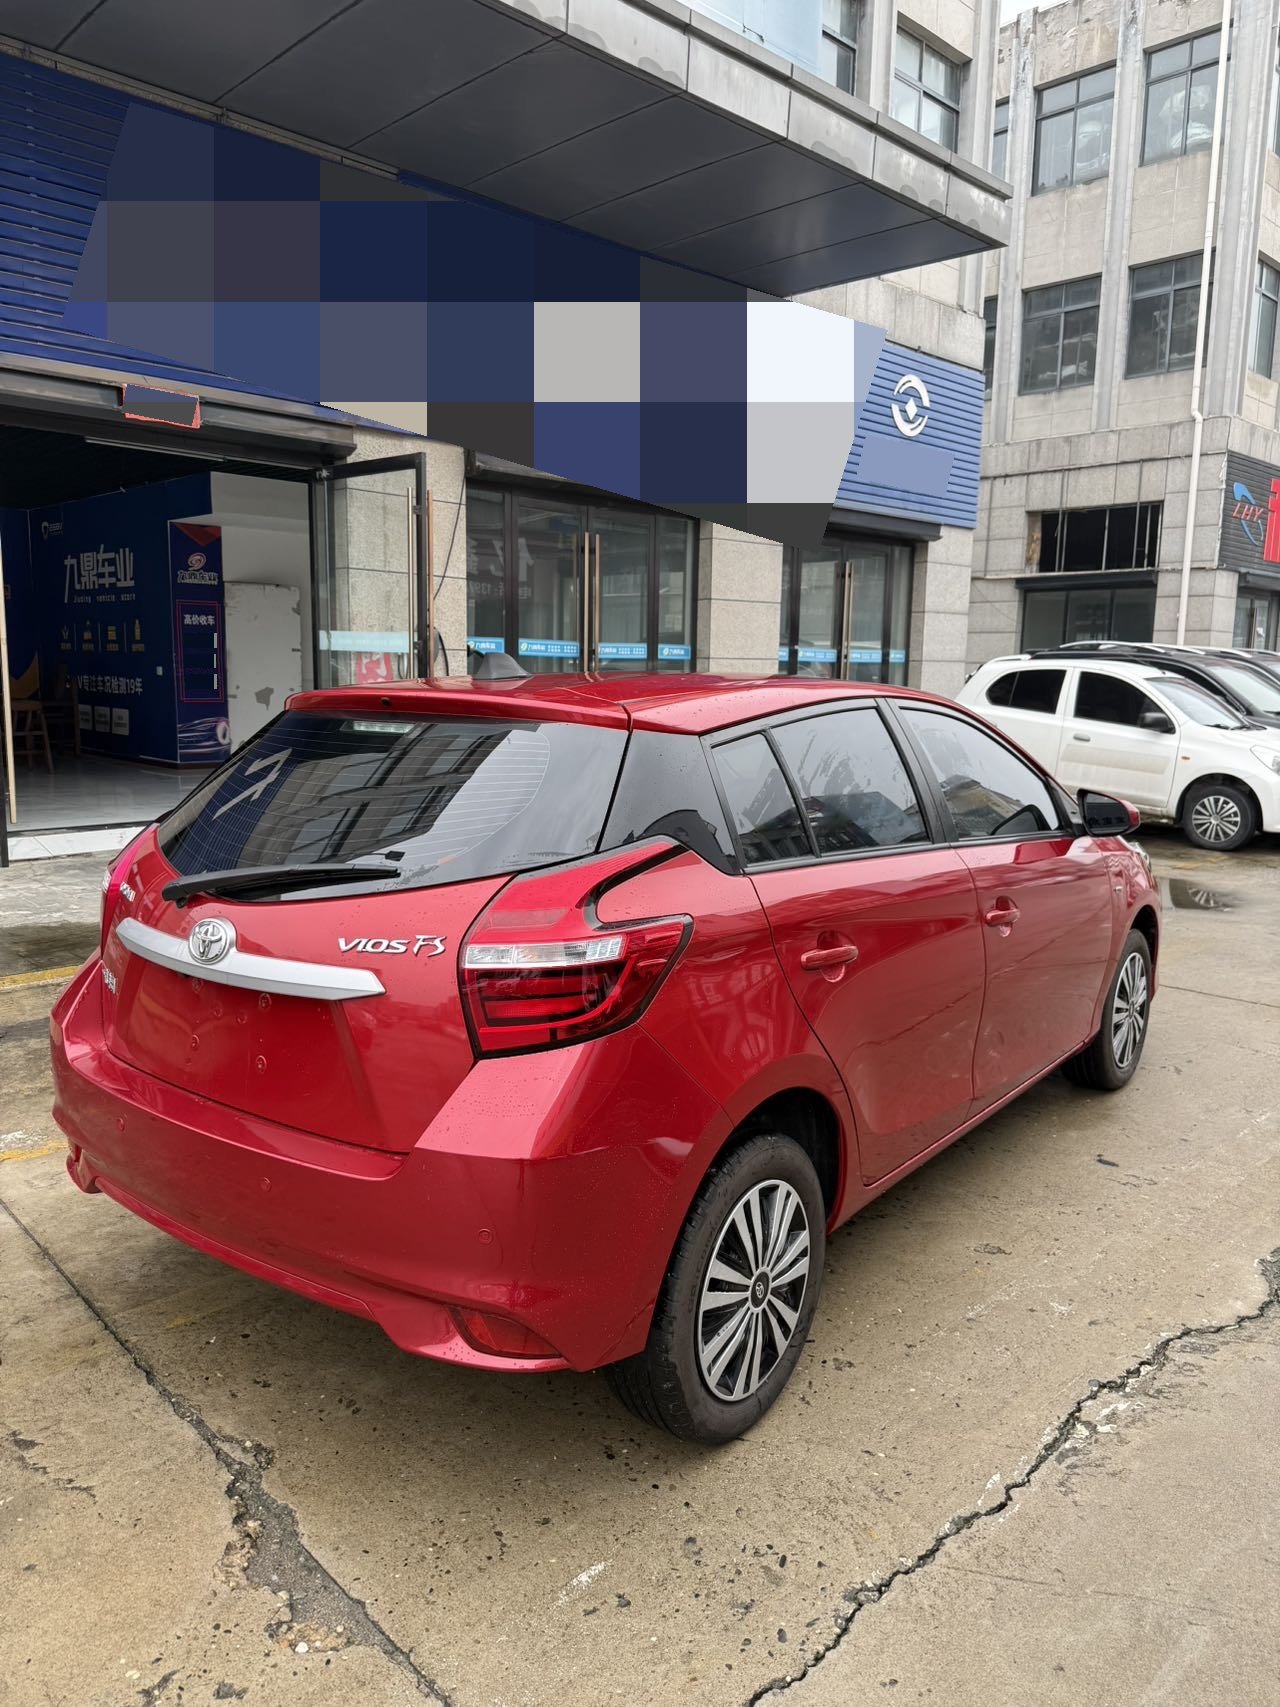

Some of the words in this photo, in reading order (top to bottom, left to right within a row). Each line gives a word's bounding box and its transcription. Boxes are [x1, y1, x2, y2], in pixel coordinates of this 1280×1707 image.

[1232, 502, 1264, 522] LHY
[64, 544, 135, 603] 九鼎车业
[183, 613, 216, 626] 高价收车
[337, 936, 410, 955] VIOS
[411, 933, 448, 958] FS
